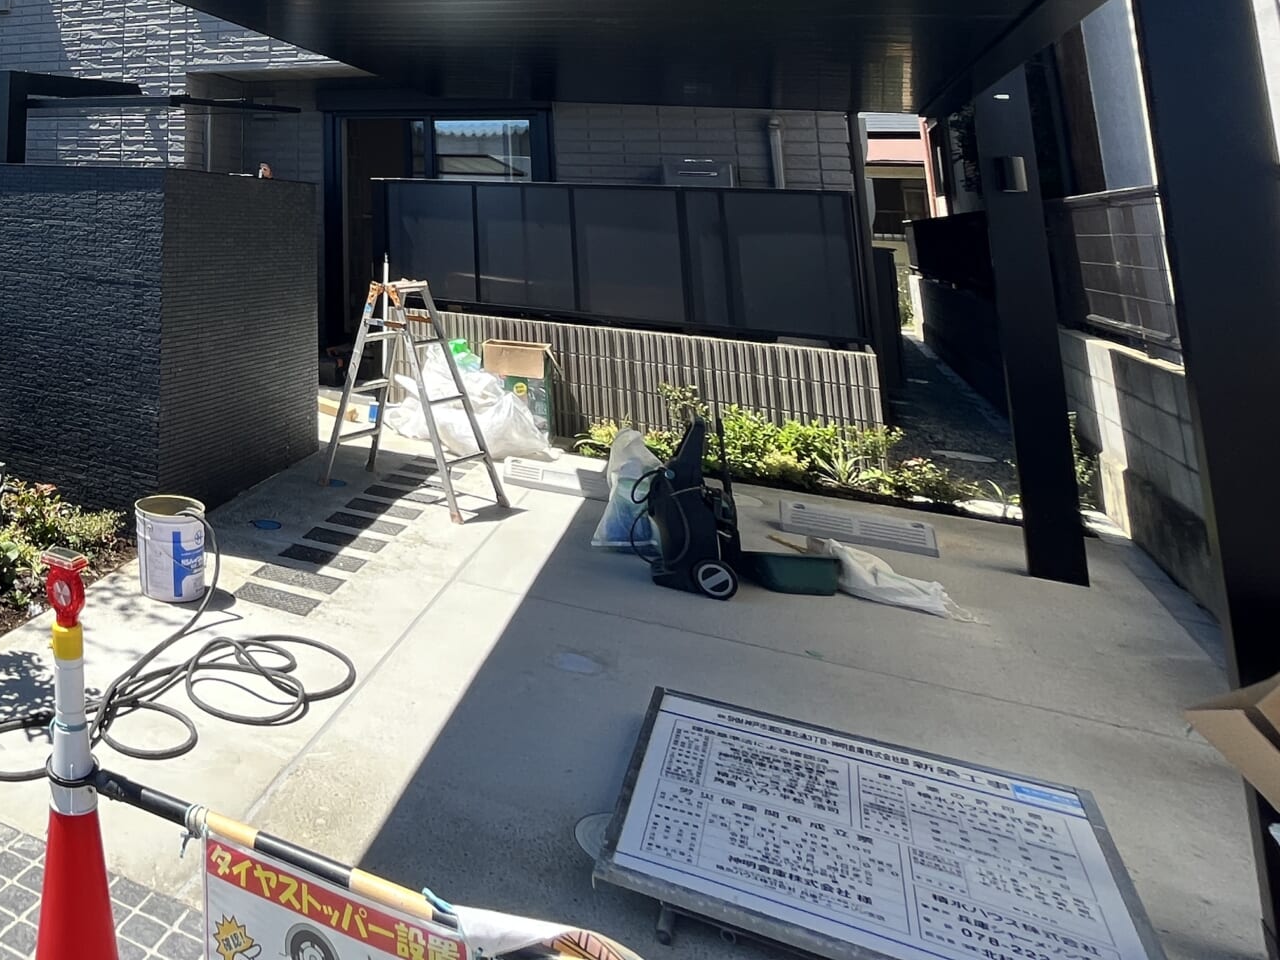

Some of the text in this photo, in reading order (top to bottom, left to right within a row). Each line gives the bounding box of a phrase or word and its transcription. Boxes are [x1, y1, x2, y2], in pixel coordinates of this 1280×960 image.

[209, 844, 462, 960] タイヤストッパー設置
[728, 854, 851, 899] 神明倉庫株式会社
[931, 893, 1102, 957] 積水ハウス株式会社
